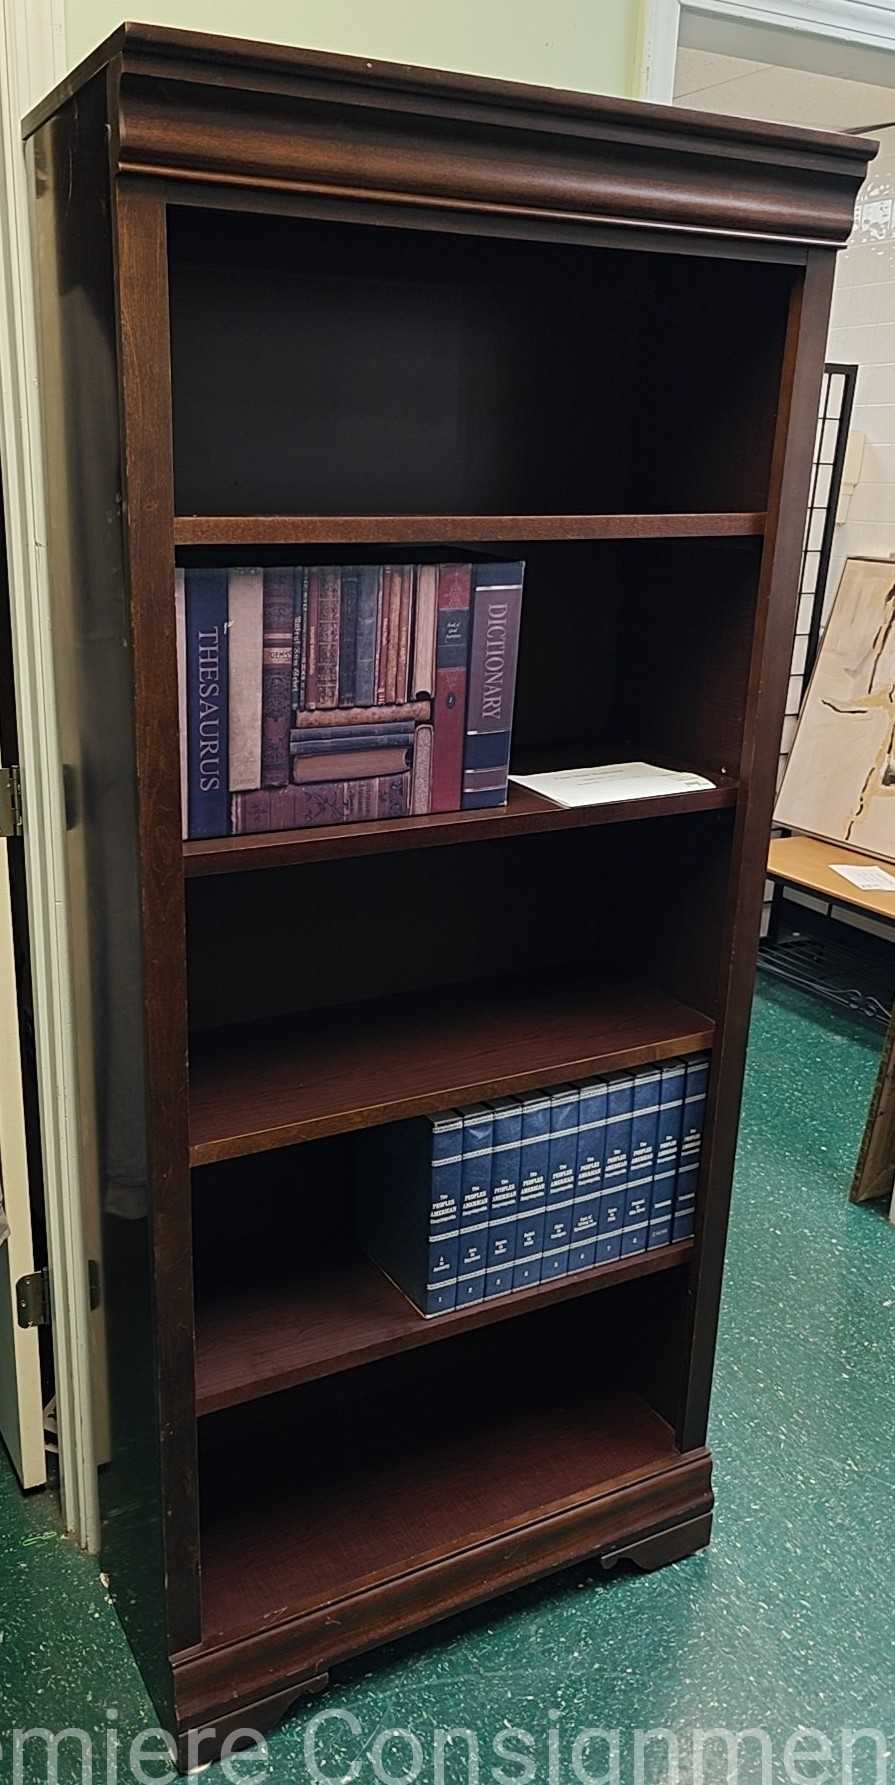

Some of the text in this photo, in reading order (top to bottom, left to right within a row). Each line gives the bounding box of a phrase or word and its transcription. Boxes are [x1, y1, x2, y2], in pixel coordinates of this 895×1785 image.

[198, 625, 221, 792] THESAURUS
[481, 603, 509, 720] DICTIONARY
[430, 1206, 457, 1217] AMERICAN
